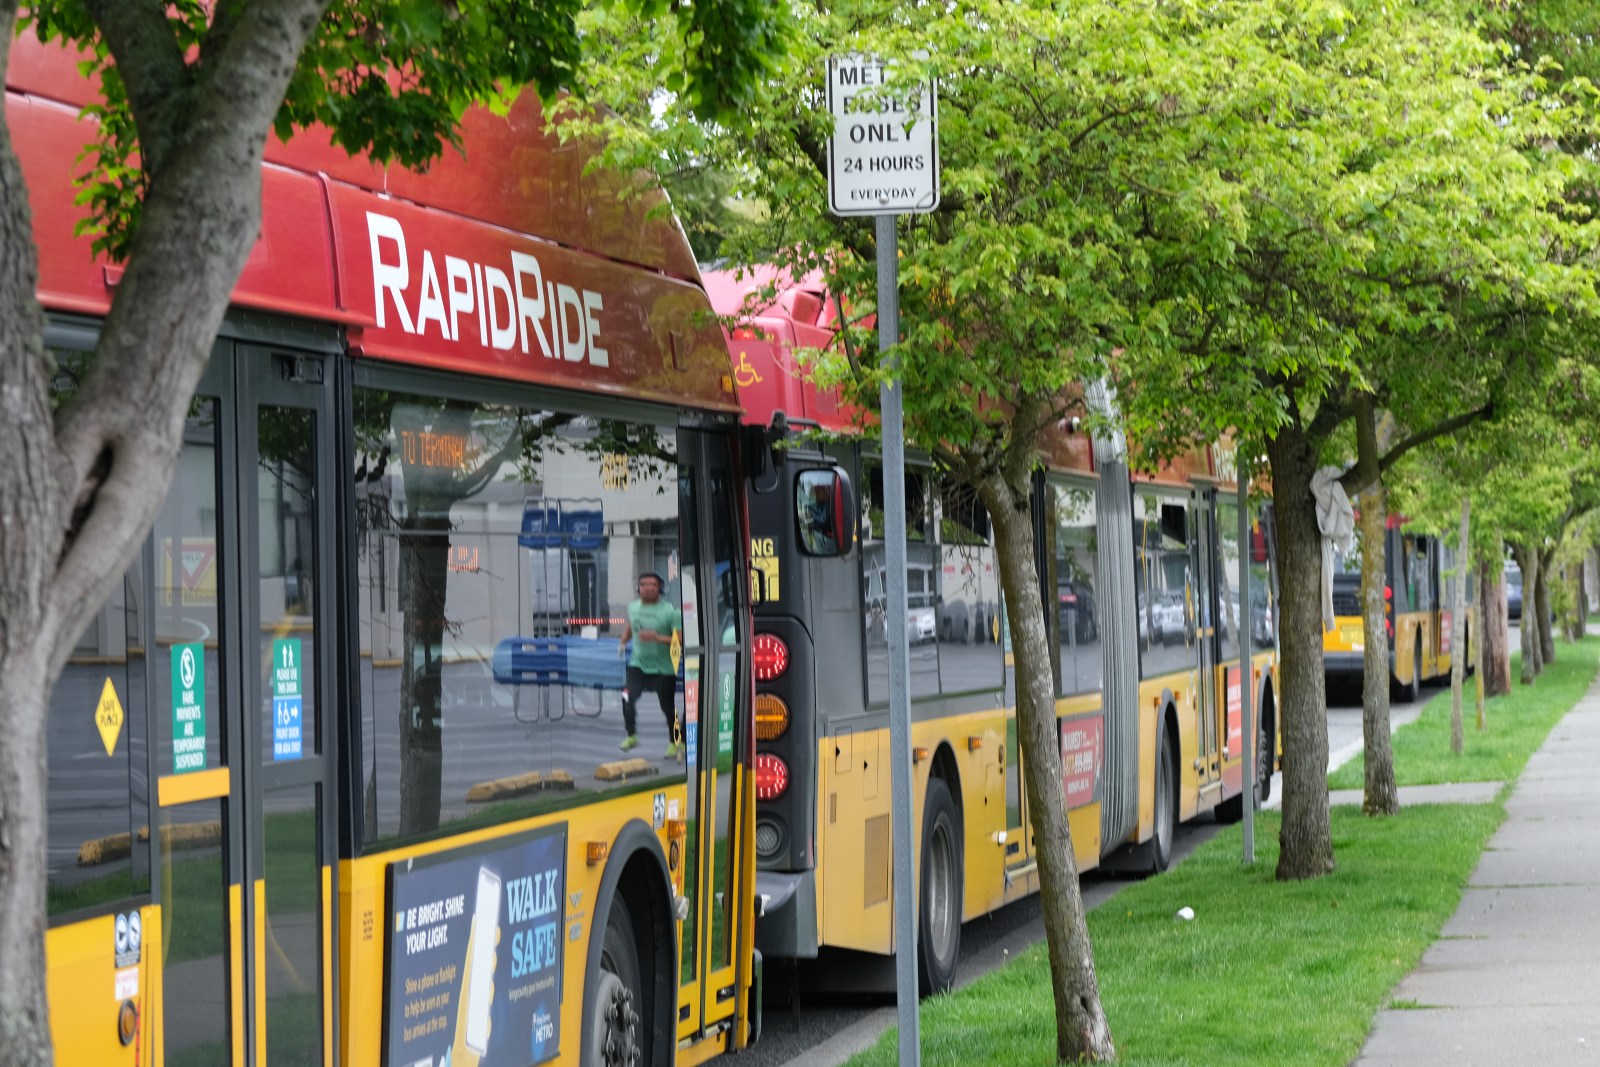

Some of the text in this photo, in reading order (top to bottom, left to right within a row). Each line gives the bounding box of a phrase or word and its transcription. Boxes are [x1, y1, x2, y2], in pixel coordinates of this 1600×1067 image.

[850, 123, 916, 144] ONLY
[844, 154, 925, 174] 24 HOURS
[851, 187, 917, 201] EVERYDAY
[402, 431, 468, 468] TO TERMINAL
[102, 700, 115, 712] SAFE
[506, 868, 558, 925] WALK
[406, 894, 465, 930] BE BRIGHT. SHINE
[406, 924, 448, 956] YOUR LIGHT.
[511, 921, 557, 979] SAFE
[535, 1022, 554, 1044] METRO
